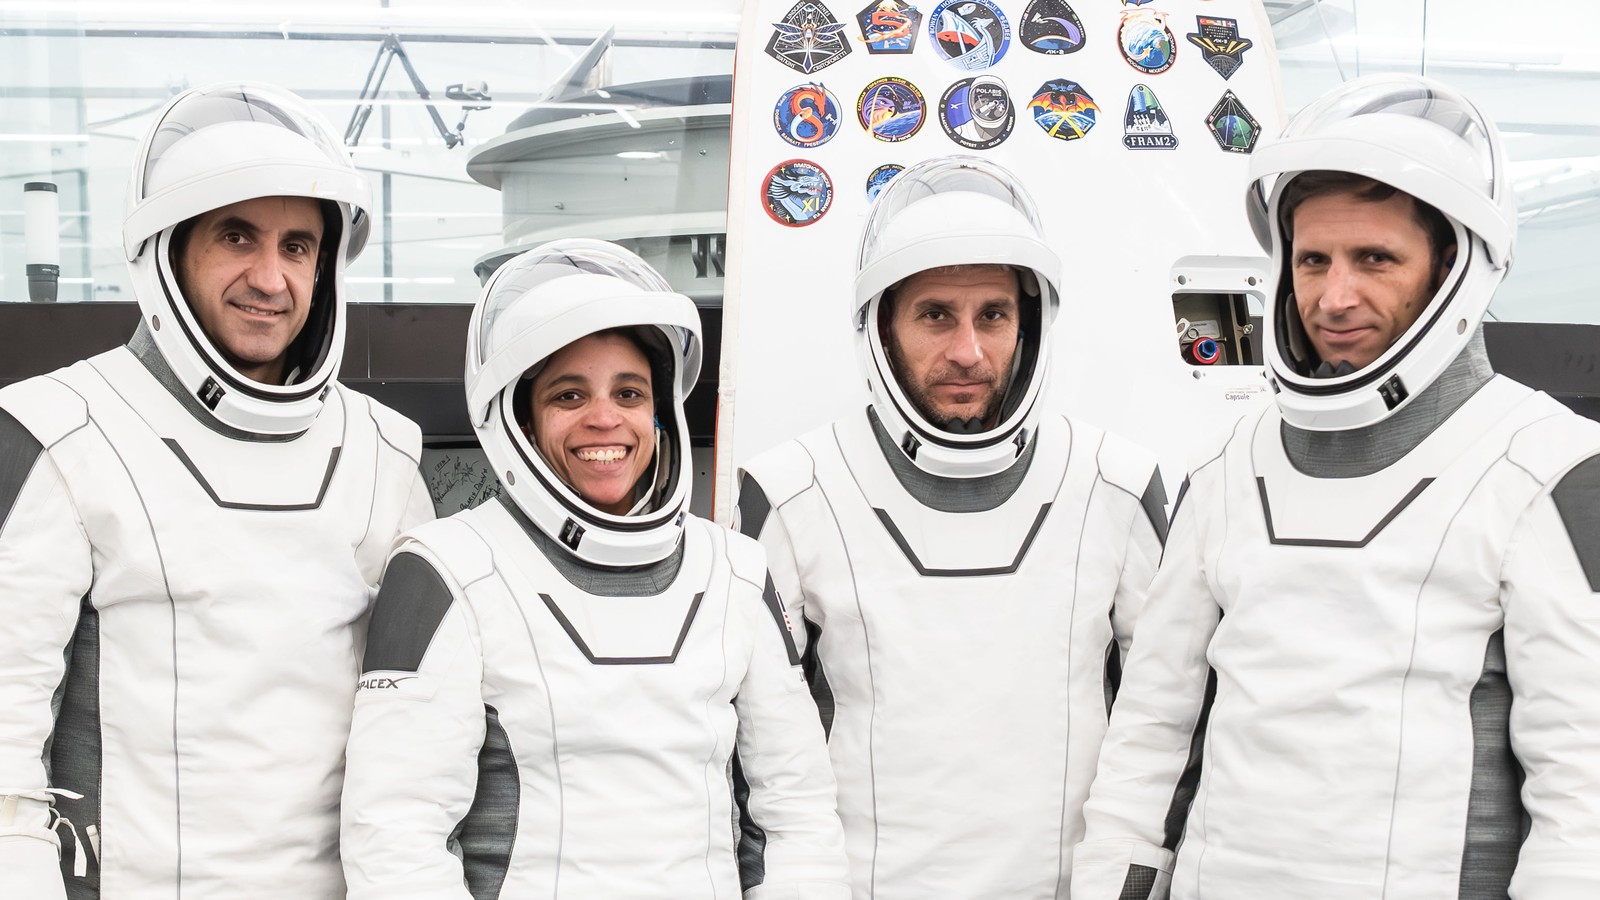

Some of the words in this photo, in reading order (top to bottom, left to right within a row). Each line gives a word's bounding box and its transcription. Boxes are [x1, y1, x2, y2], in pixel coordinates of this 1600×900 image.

[1130, 136, 1171, 146] FRAM2
[801, 197, 820, 213] XI
[1225, 393, 1250, 401] Capsule
